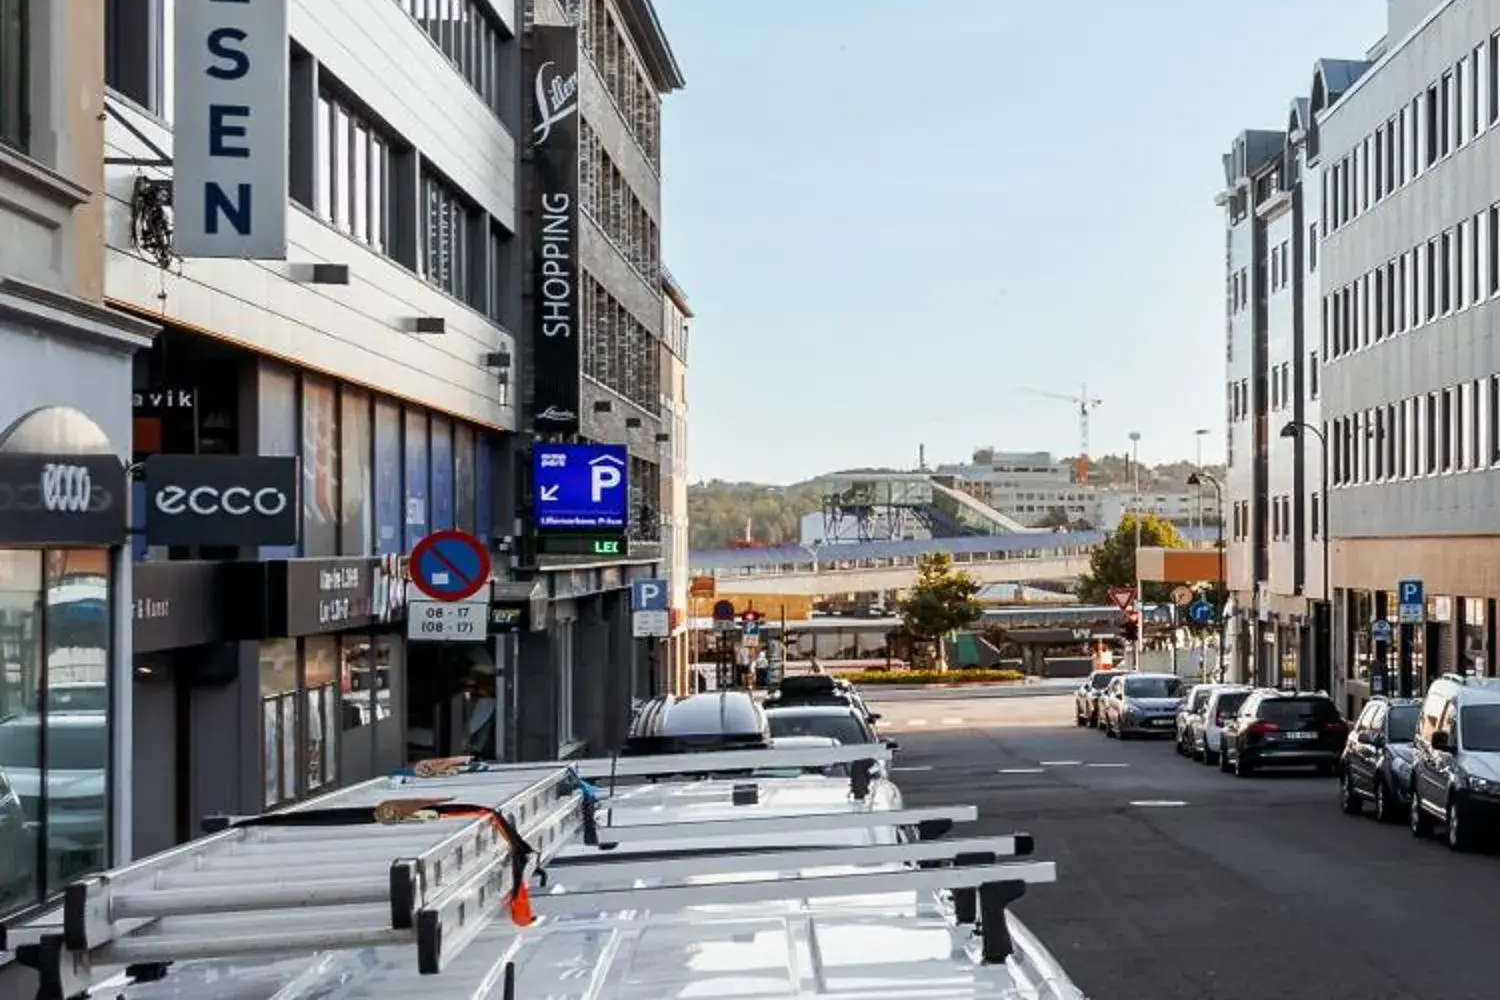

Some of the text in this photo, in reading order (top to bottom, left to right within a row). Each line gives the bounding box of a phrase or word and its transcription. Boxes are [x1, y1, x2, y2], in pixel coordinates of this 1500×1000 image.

[541, 193, 570, 338] SHOPPING
[591, 466, 621, 502] P
[156, 486, 287, 515] ecco
[641, 583, 659, 608] P
[1404, 583, 1417, 602] P
[425, 607, 443, 618] 08
[457, 607, 470, 618] 17
